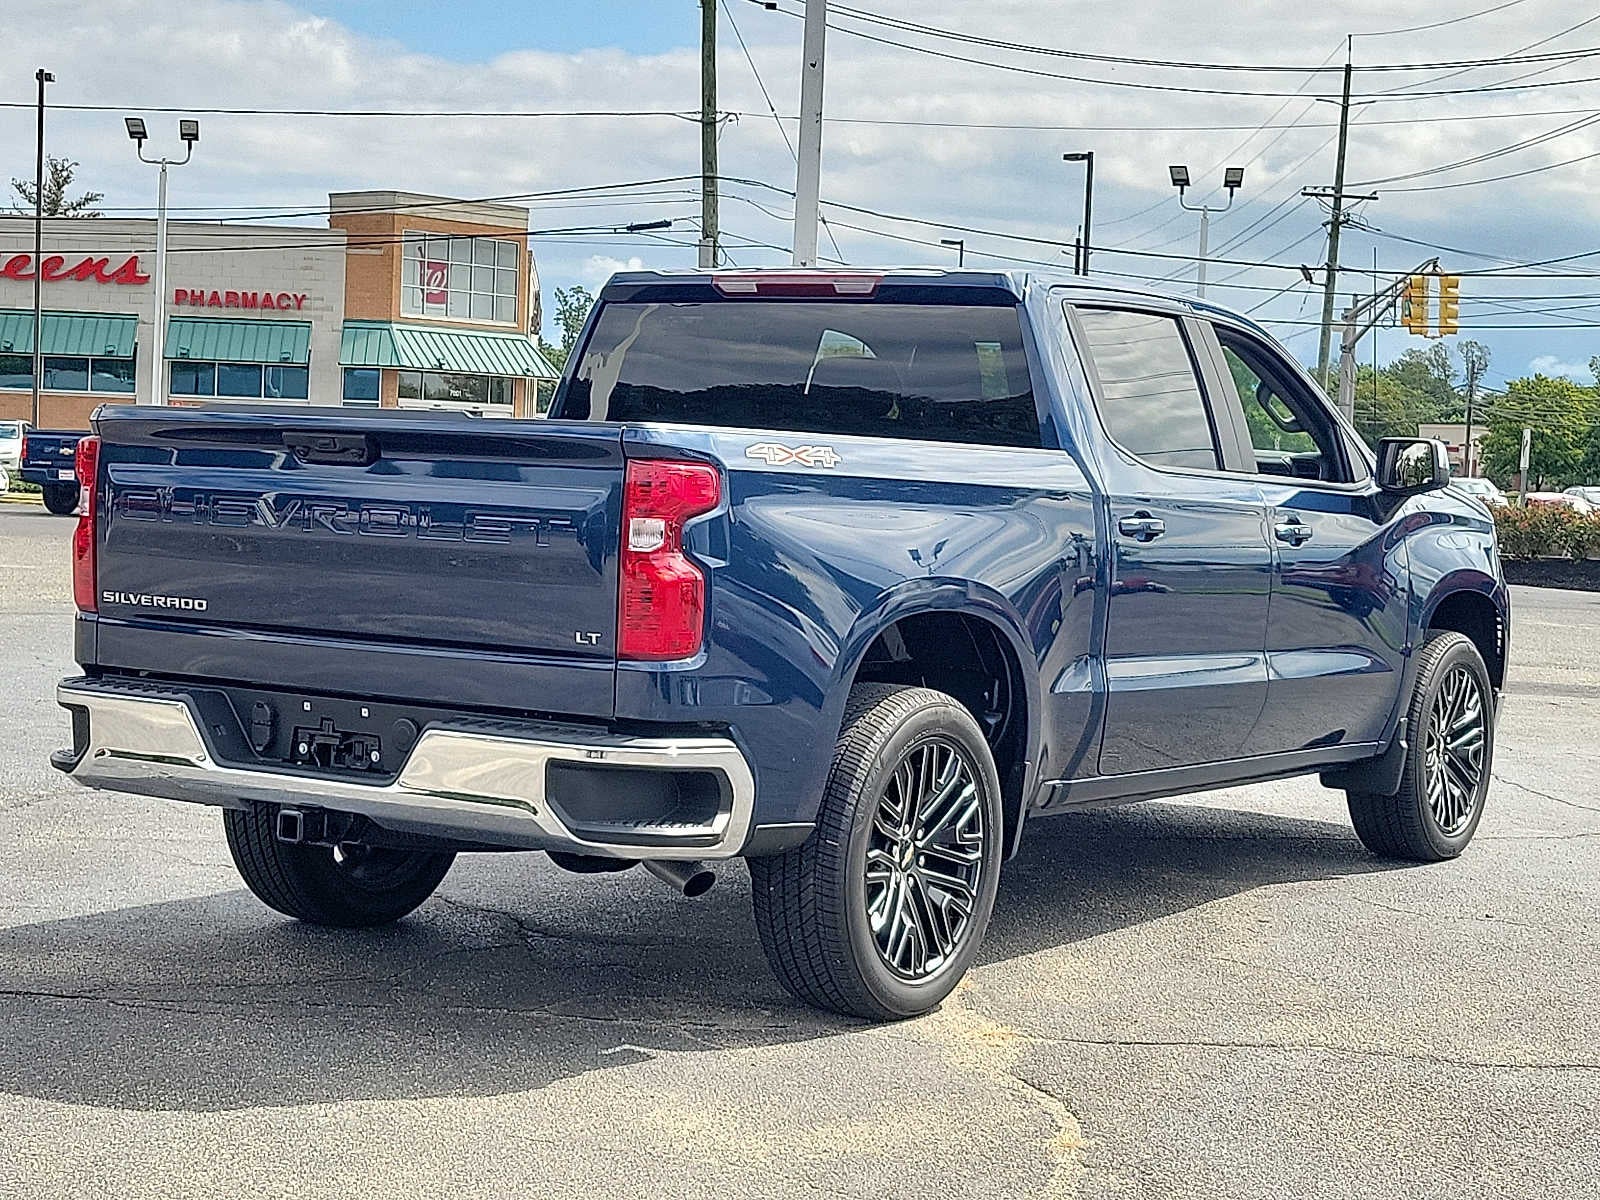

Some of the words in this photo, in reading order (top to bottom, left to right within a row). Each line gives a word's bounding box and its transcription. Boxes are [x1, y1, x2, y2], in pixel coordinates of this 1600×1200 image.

[174, 288, 307, 311] PHARMACY
[119, 488, 573, 547] CHEVROLET
[103, 590, 208, 612] SILVERADO
[575, 631, 602, 645] LT
